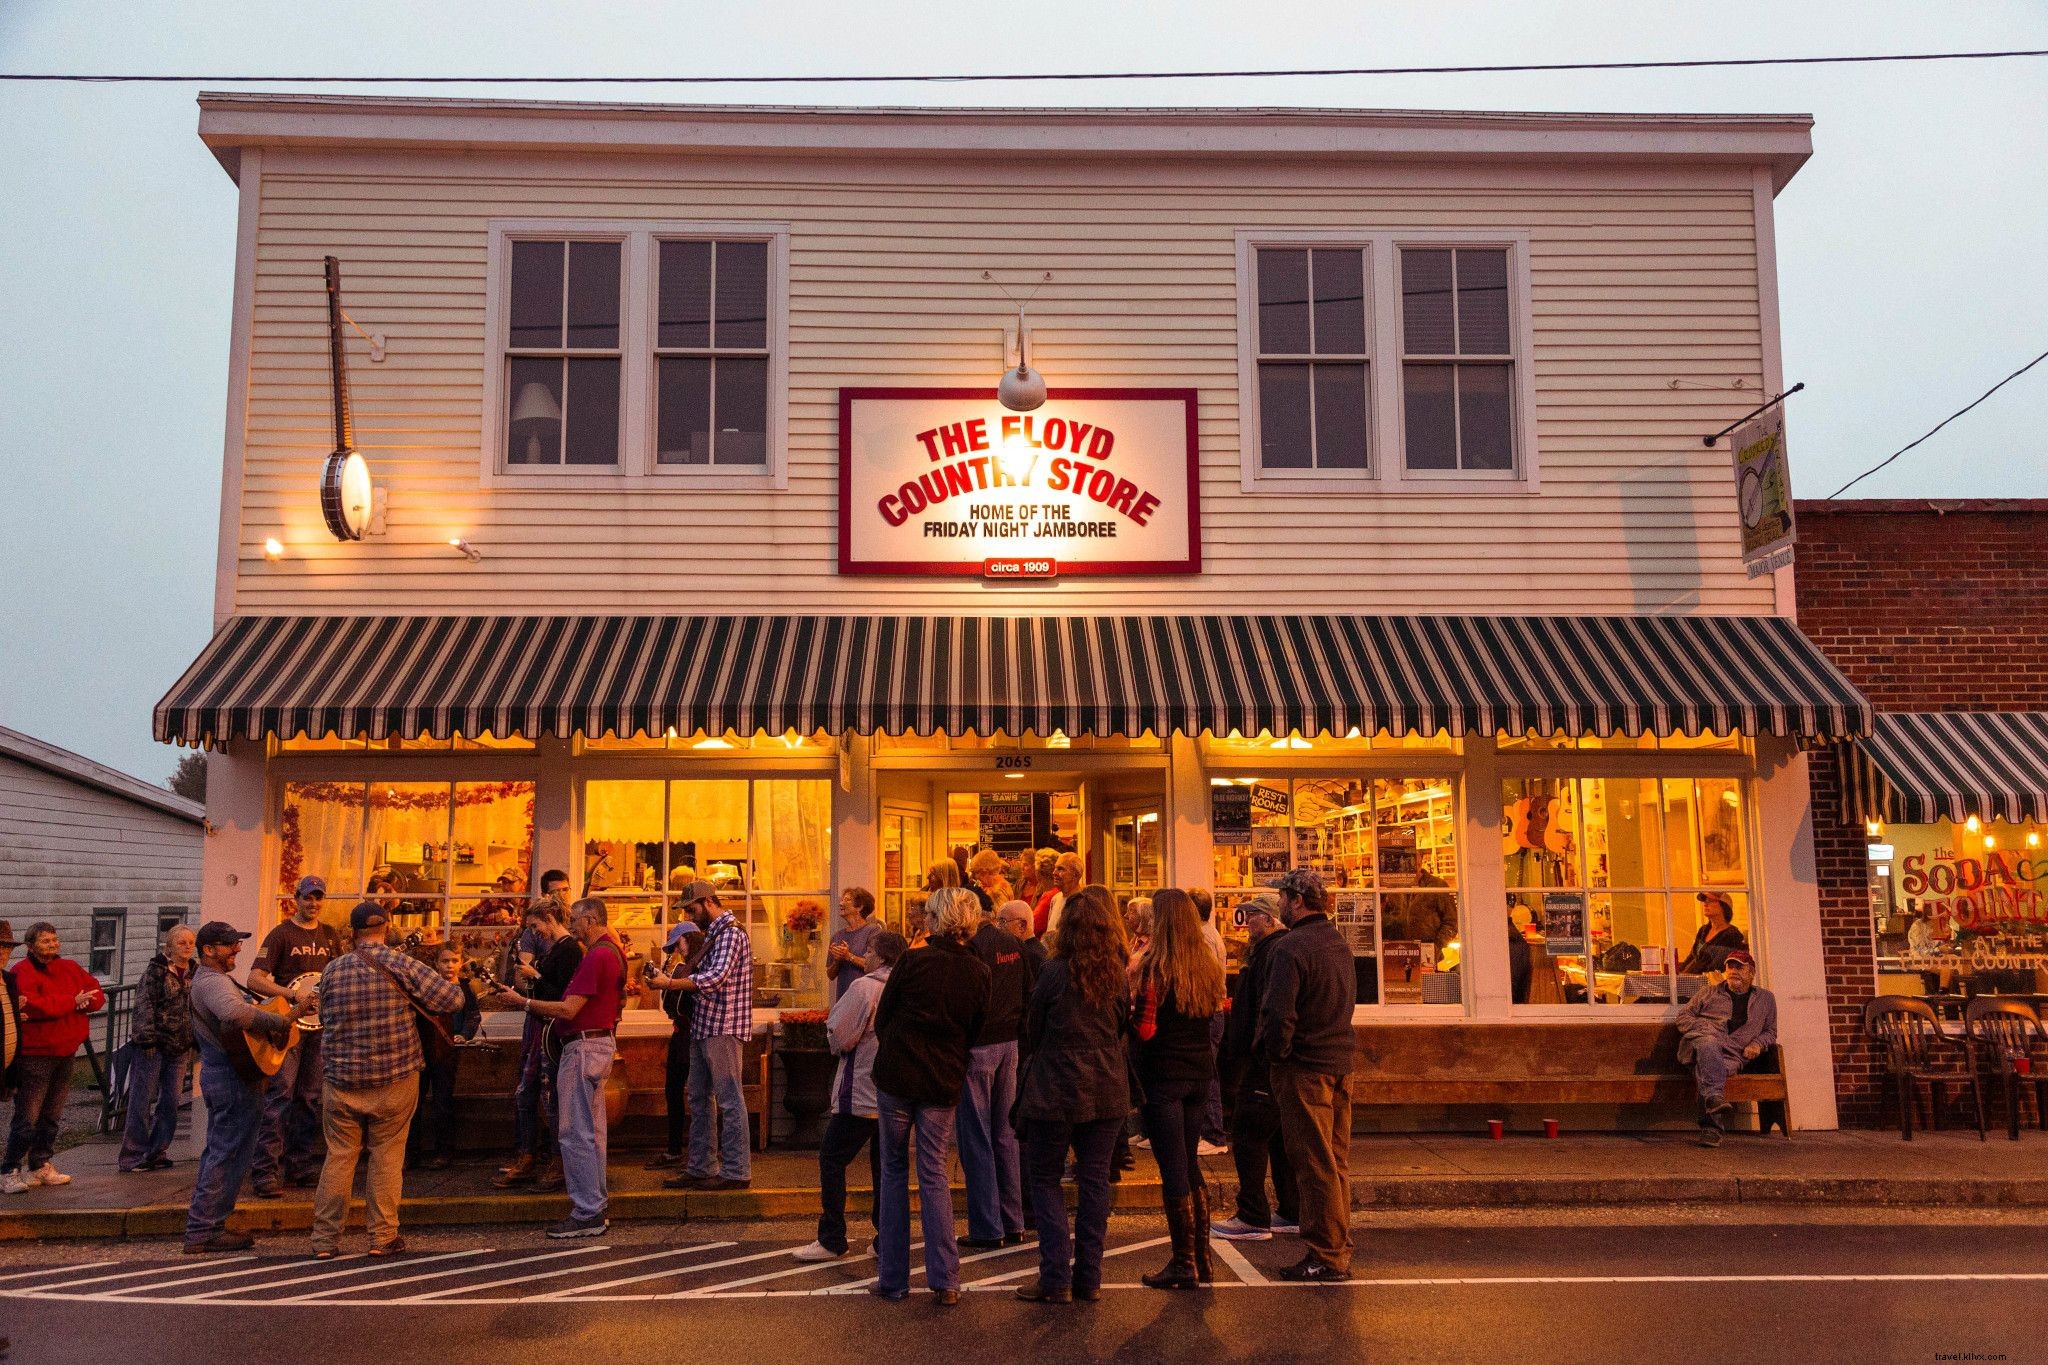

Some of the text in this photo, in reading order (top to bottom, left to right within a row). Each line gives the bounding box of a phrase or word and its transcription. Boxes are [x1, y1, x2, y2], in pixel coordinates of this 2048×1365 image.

[916, 416, 1115, 462] THE FLOYD
[877, 454, 1161, 528] COUNTRY STORE
[970, 504, 1070, 520] HOME OF THE
[923, 521, 1117, 538] FRIDAY NIGHT JAMBOREE
[991, 562, 1050, 573] circa 1909
[996, 756, 1032, 768] 206S
[1257, 788, 1286, 803] REST
[1251, 796, 1287, 813] ROOMS
[1260, 834, 1280, 842] SPECIAL
[1933, 847, 1954, 858] the
[1902, 853, 2016, 896] SODA
[1923, 886, 2048, 941] FOUNT
[2006, 934, 2043, 948] THE
